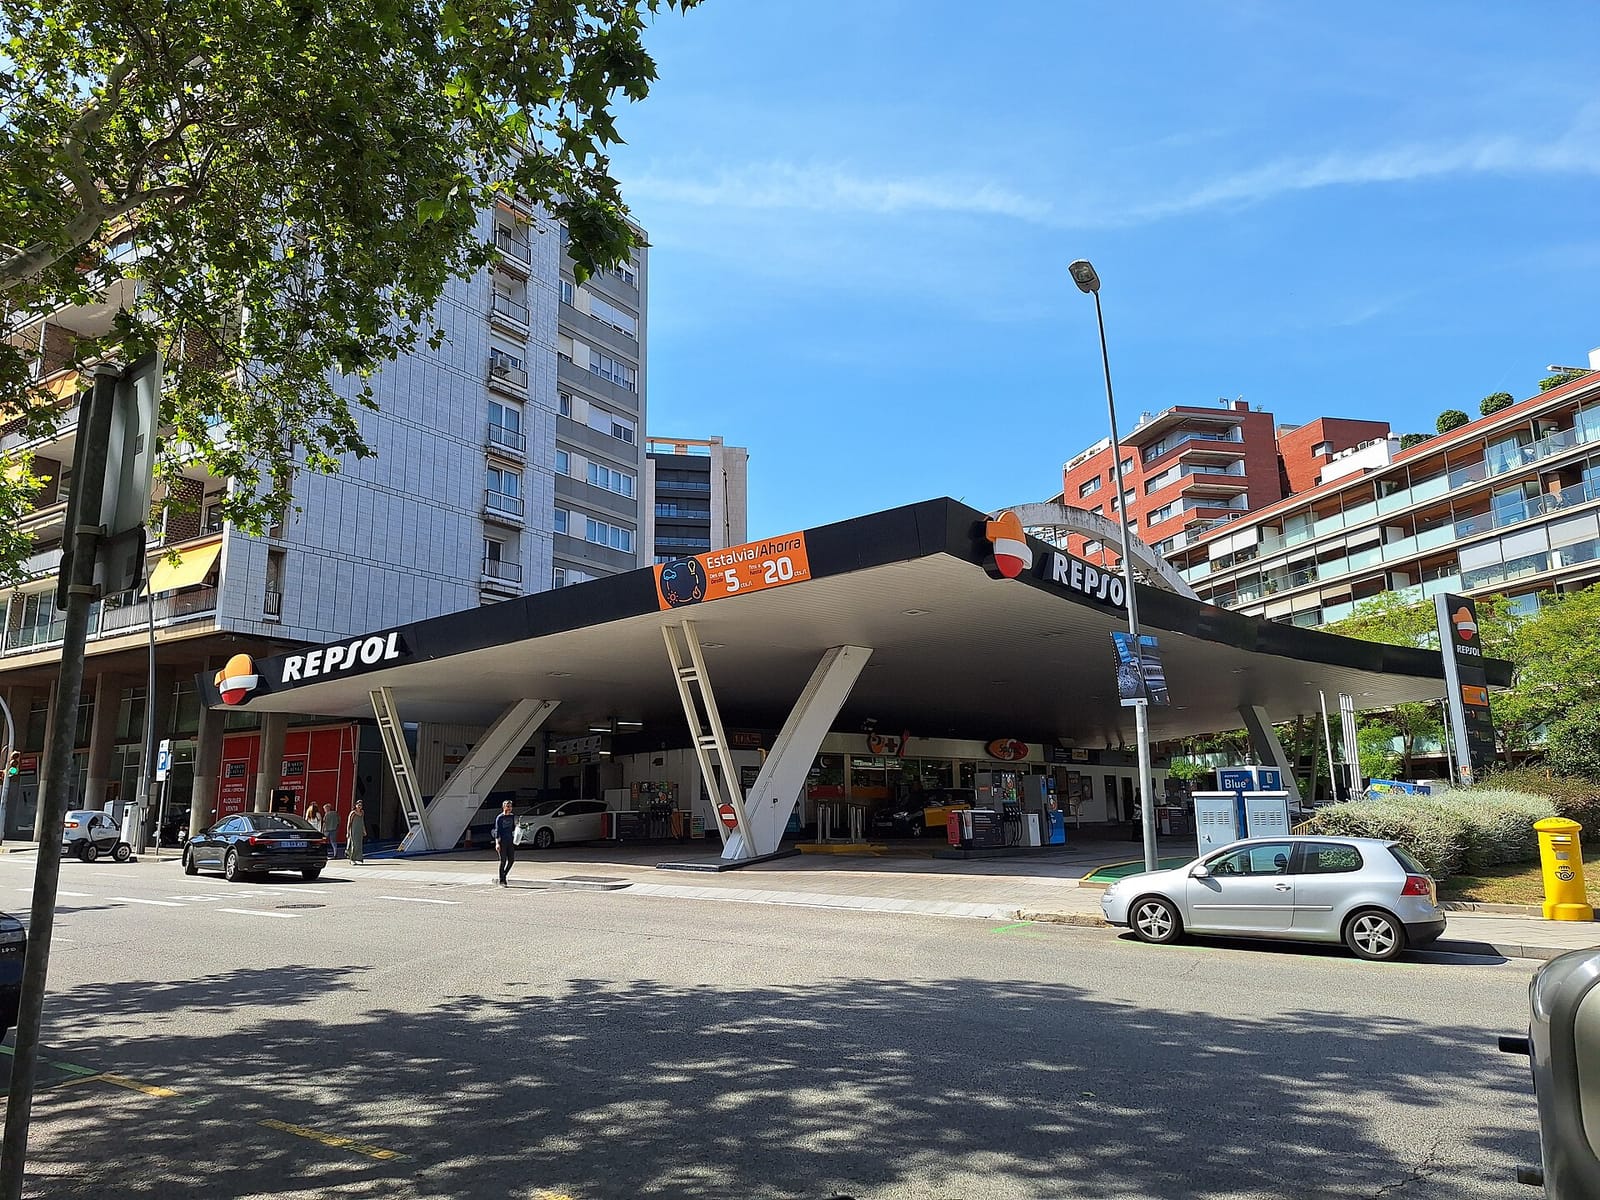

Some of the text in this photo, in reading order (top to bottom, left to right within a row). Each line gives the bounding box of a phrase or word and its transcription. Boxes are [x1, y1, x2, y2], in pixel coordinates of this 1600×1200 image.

[706, 538, 801, 569] Estalvia/Ahorra
[724, 568, 740, 592] 5
[762, 556, 794, 584] 20
[1052, 551, 1128, 609] REPSO
[281, 631, 399, 683] REPSOL
[1456, 644, 1481, 657] REPSOL
[1224, 778, 1247, 789] Blue
